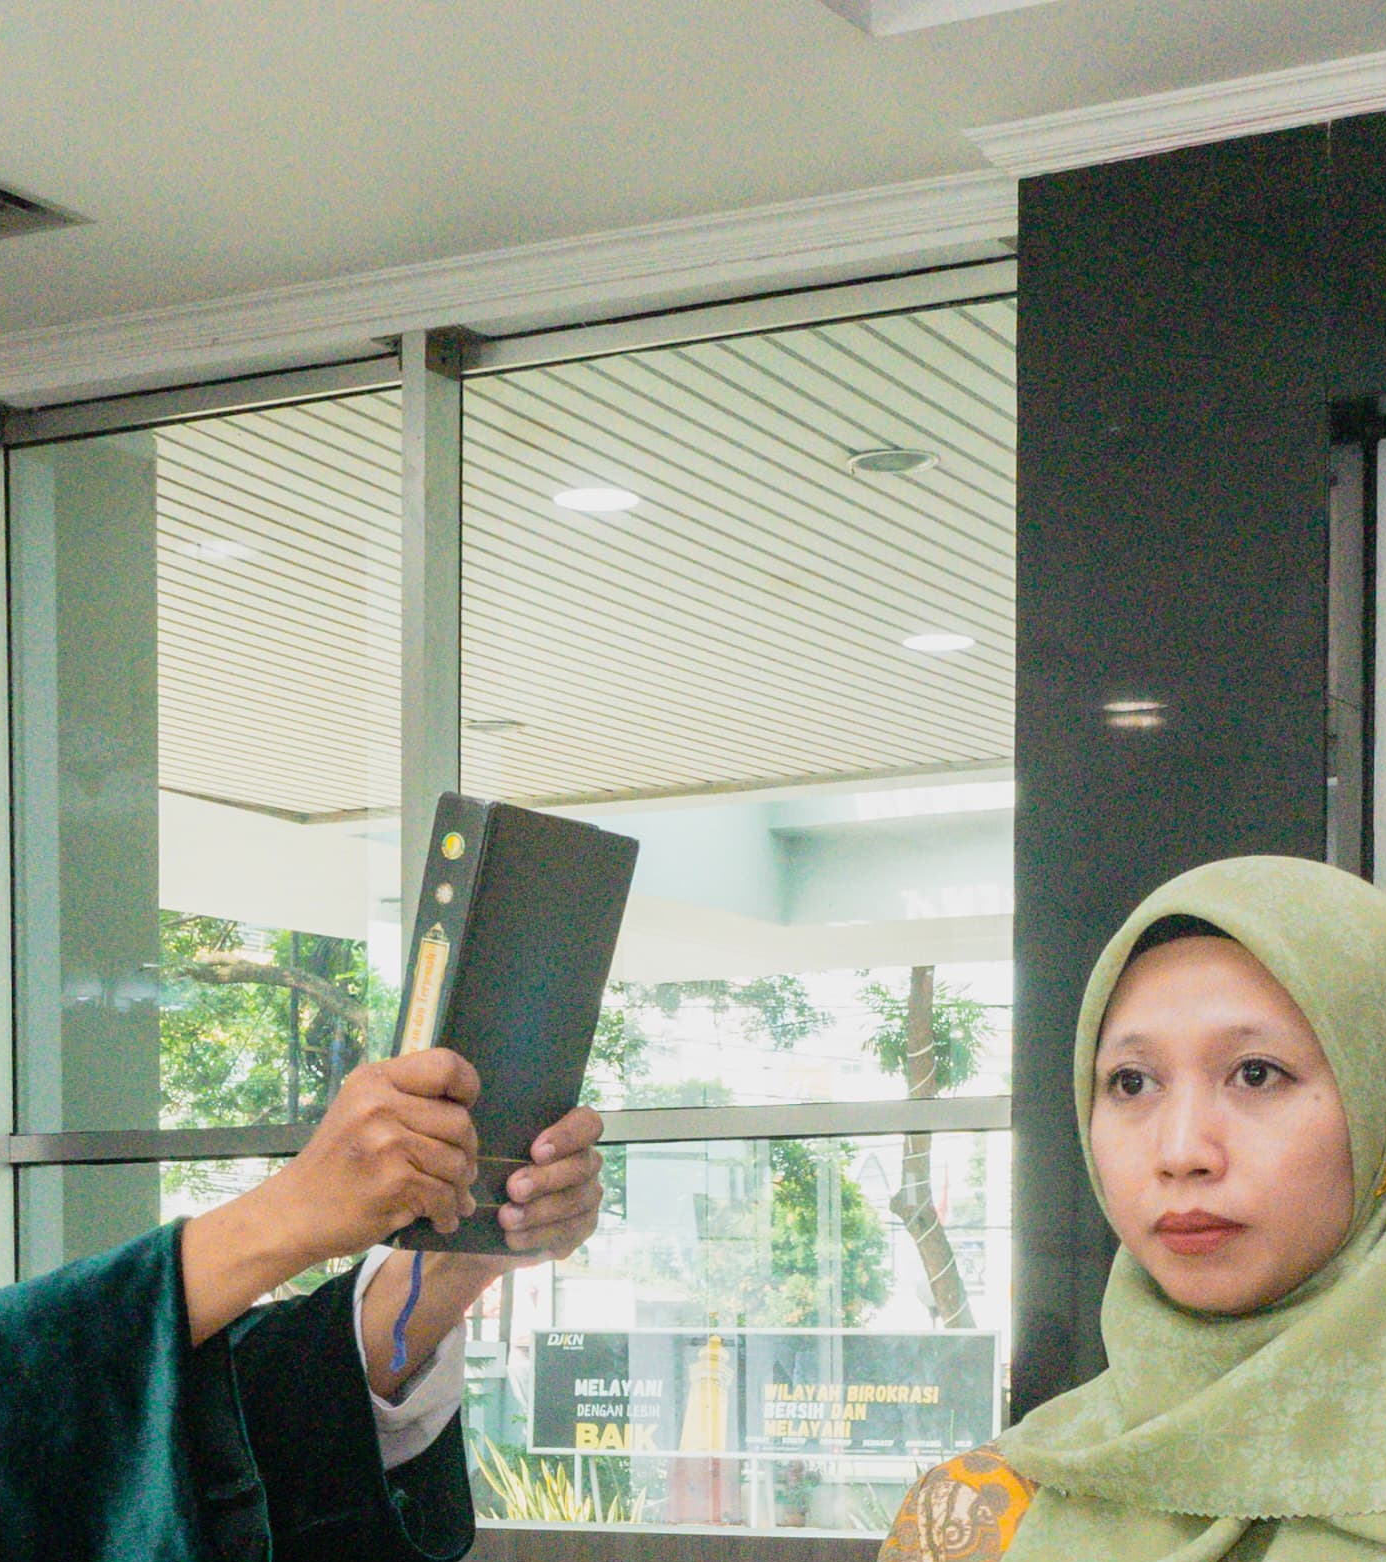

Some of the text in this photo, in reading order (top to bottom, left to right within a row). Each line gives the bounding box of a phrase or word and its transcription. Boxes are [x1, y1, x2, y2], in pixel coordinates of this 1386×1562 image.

[547, 1333, 585, 1347] DJKN
[574, 1378, 663, 1398] MELAYANI
[847, 1385, 940, 1404] BIROKRASI
[577, 1403, 661, 1418] DENGAN LEBIH
[764, 1401, 867, 1421] BERSIH DAN
[575, 1422, 660, 1450] BAIK
[764, 1419, 852, 1439] MELAYANI
